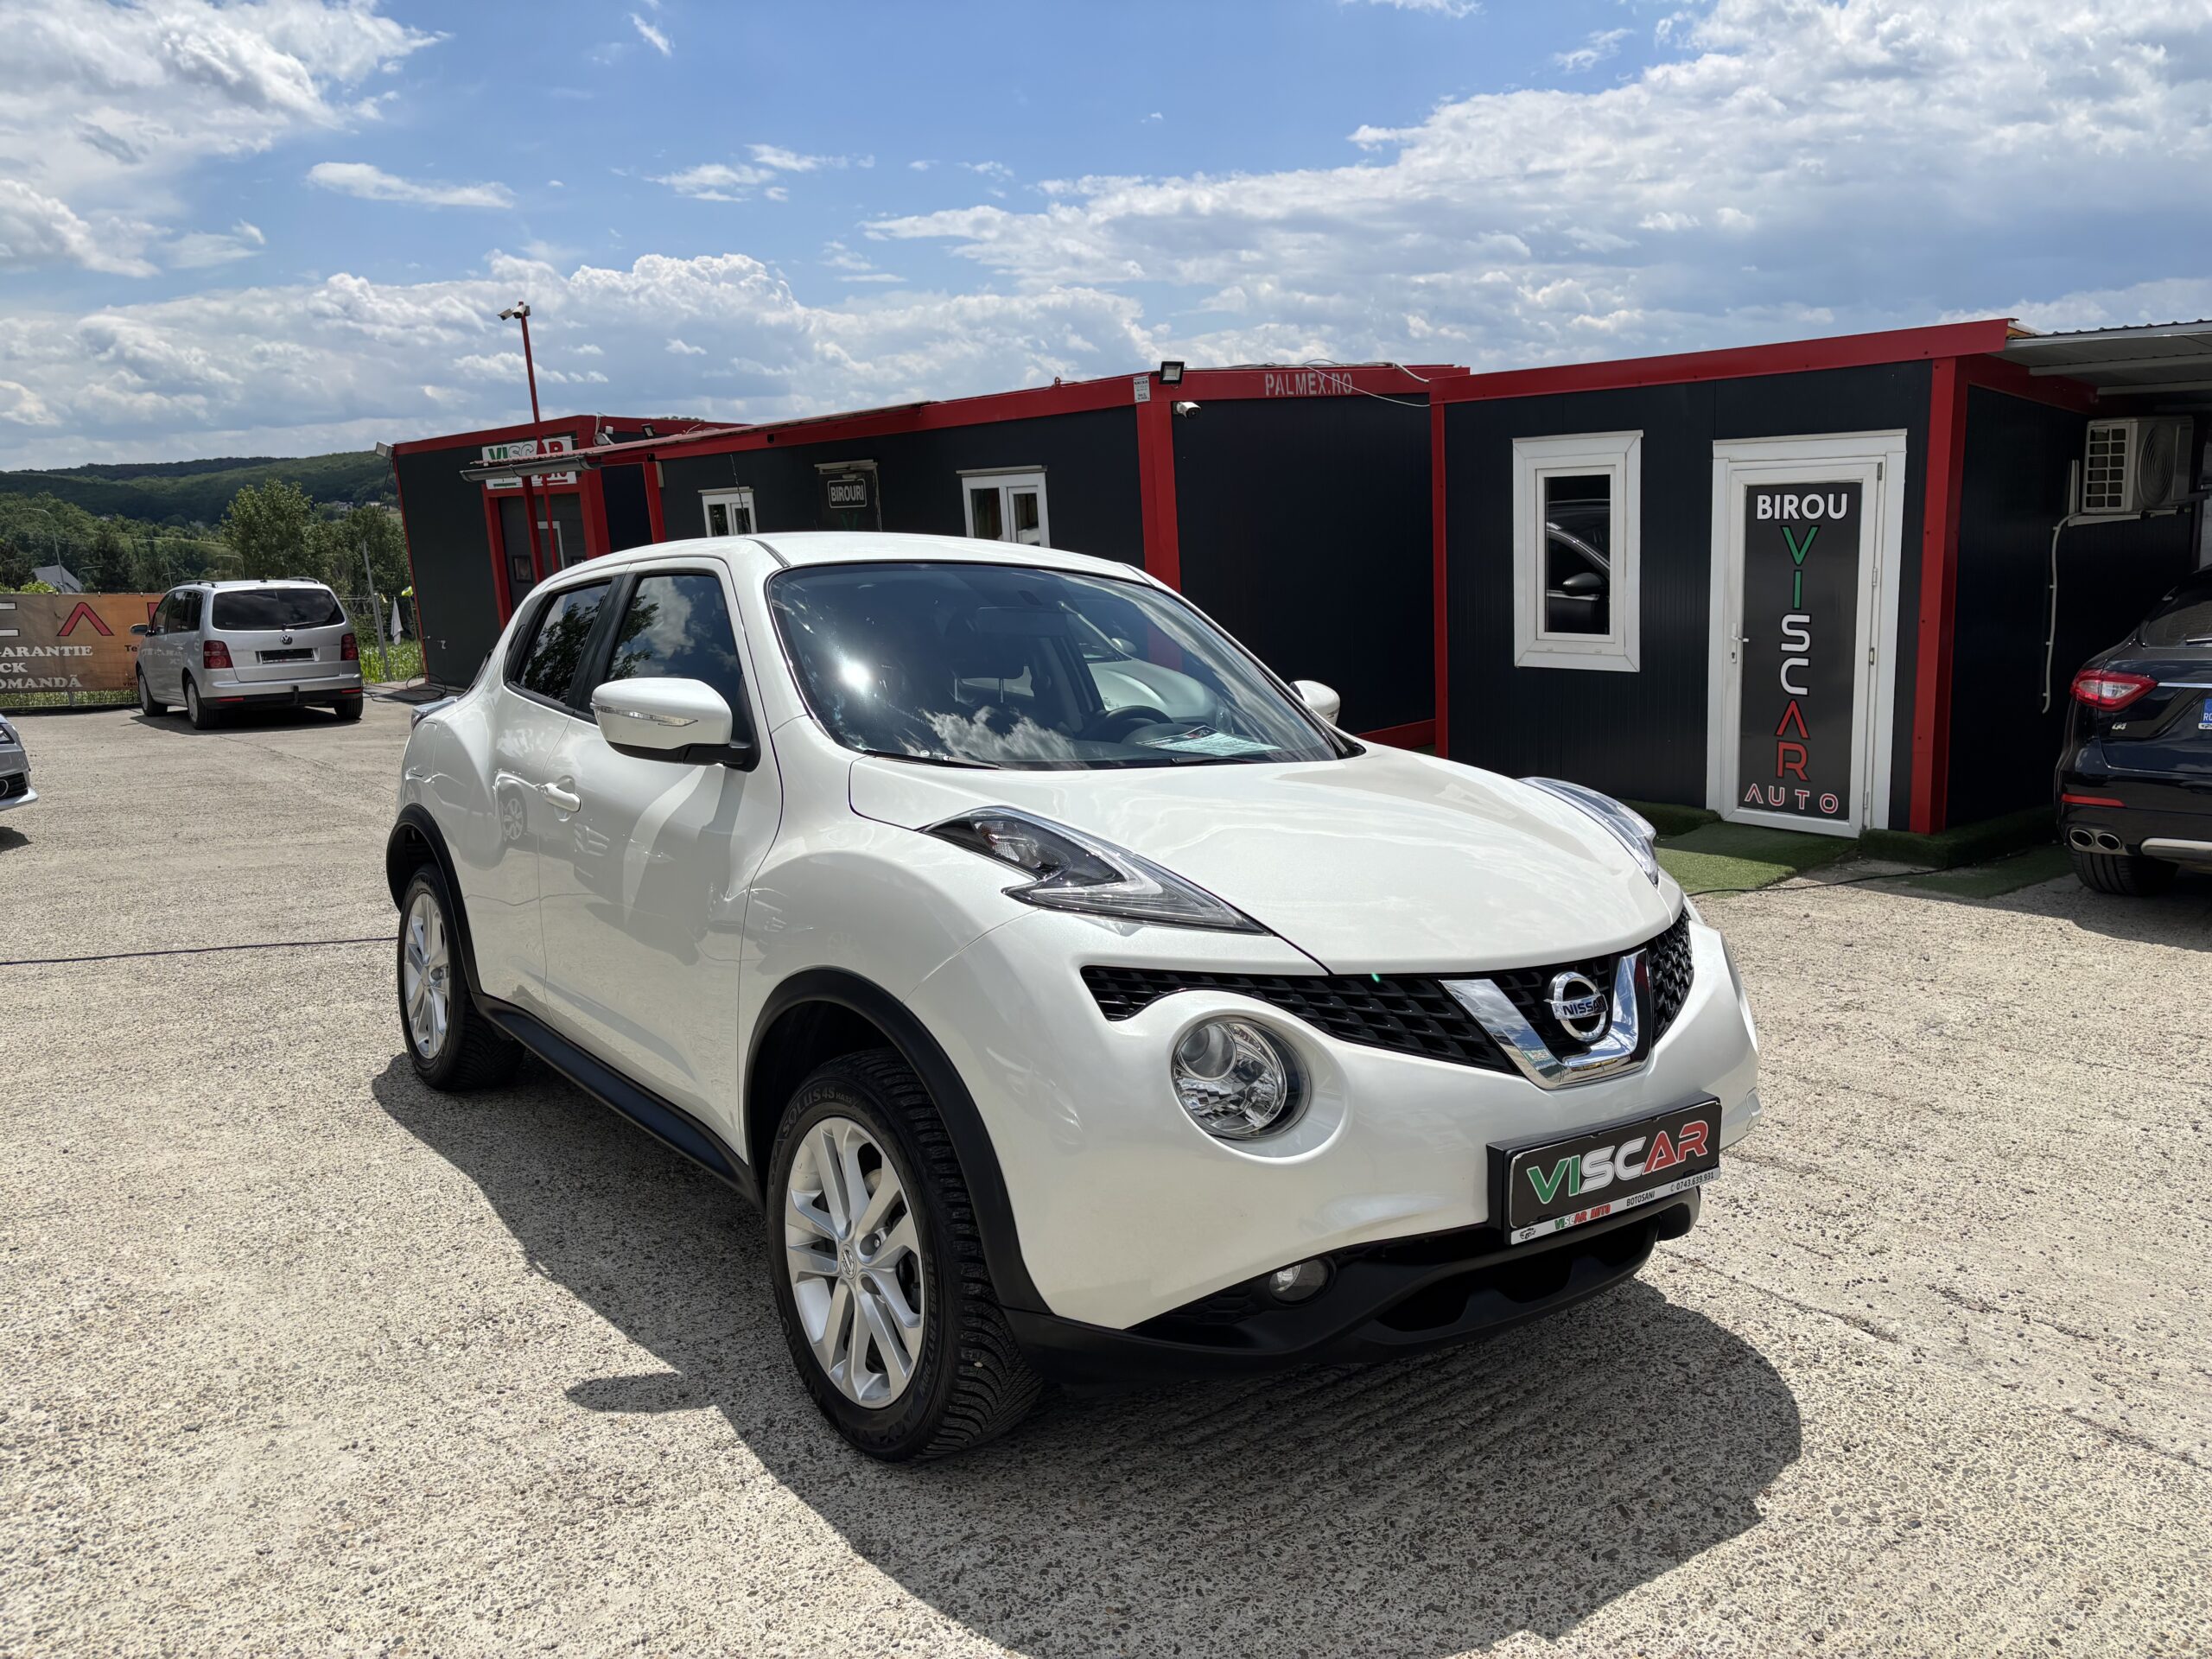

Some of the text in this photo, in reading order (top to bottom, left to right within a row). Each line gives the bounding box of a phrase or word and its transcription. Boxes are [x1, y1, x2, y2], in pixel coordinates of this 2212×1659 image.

[1265, 372, 1352, 396] PALMEX.RO
[830, 485, 864, 501] BIROURI
[1757, 493, 1847, 520] BIROU
[0, 645, 92, 657] ARANTIE
[1744, 783, 1839, 814] AUTO
[1562, 997, 1605, 1015] NISSAN
[1526, 1120, 1709, 1205] VISCAR
[1554, 1172, 1714, 1230] VISCAR AUTO BOTOSANI 0743.639.931
